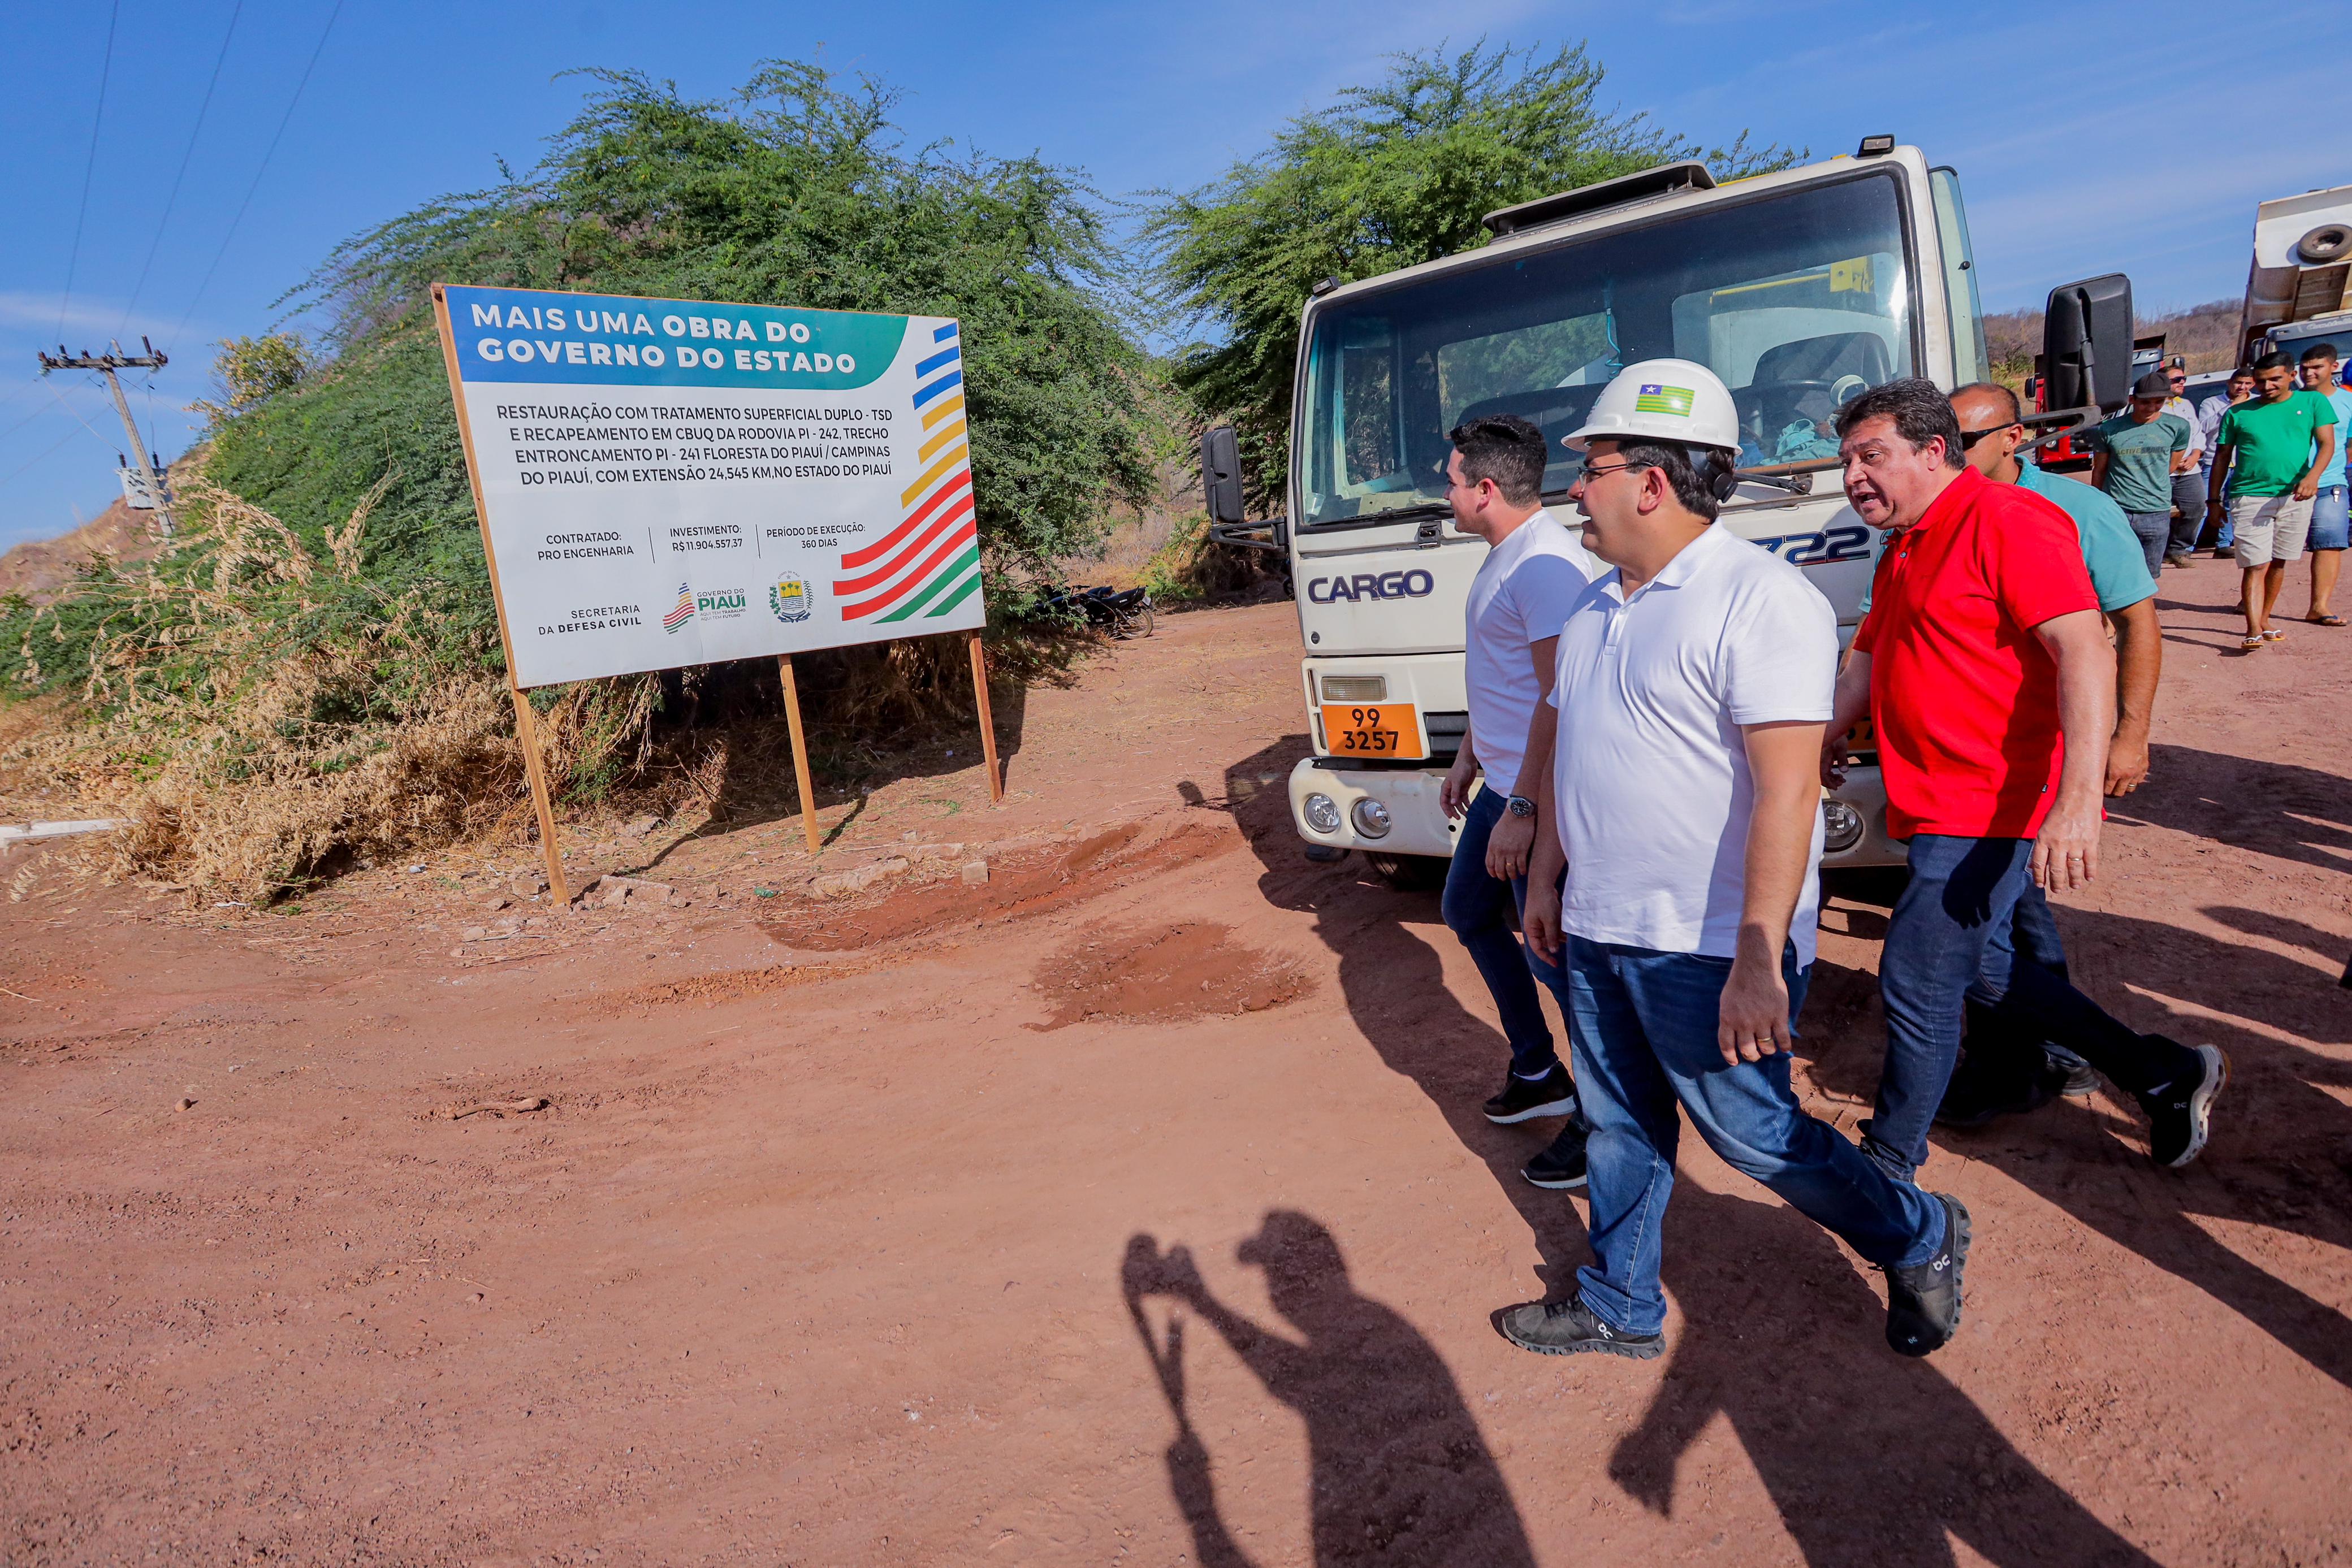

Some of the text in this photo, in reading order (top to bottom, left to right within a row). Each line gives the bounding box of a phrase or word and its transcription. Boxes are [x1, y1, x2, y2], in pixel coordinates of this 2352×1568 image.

[471, 304, 810, 343] MAIS UMA OBRA DO
[477, 337, 855, 373] GOVERNO DO ESTADO
[496, 402, 612, 423] RESTAURAÇÃO
[615, 406, 648, 419] COM
[650, 406, 741, 420] TRATAMENTO
[744, 408, 822, 421] SUPERFICIAL
[824, 409, 863, 421] DUPLO
[871, 409, 892, 421] TSD
[509, 427, 521, 441] E
[524, 427, 648, 441] RECAPEAMENTO
[651, 427, 672, 440] EM
[675, 427, 715, 443] CBUQ
[716, 427, 736, 440] DA
[738, 427, 796, 440] RODOVIA
[798, 427, 810, 439] PI
[819, 427, 842, 440] 242,
[843, 427, 889, 439] TRECHO
[515, 448, 652, 463] ENTRONCAMENTO
[655, 448, 668, 461] PI
[679, 448, 701, 460] 241
[703, 447, 769, 460] FLORESTA
[771, 447, 789, 459] DO
[791, 443, 823, 458] PIAUÍ
[831, 445, 890, 458] CAMPINAS
[521, 471, 544, 485] DO
[548, 466, 593, 484] PIAUÍ,
[595, 469, 629, 483] COM
[632, 464, 706, 481] EXTENSÃO
[708, 467, 749, 481] 24,545
[795, 465, 840, 478] ESTADO
[842, 465, 860, 476] DO
[862, 461, 892, 475] PIAUÍ
[546, 531, 622, 545] CONTRATADO:
[669, 525, 742, 538] INVESTIMENTO:
[766, 521, 866, 538] PERÍODO DE EXECUÇÃO:
[672, 538, 742, 553] R$ 11.904.557,37
[801, 538, 838, 549] 360 DIAS
[538, 545, 634, 561] PRO ENGENHARIA
[697, 589, 732, 597] GOVERNO
[1308, 569, 1434, 604] CARGO
[571, 604, 641, 620] SECRETARIA
[697, 594, 746, 612] PIAUÍ
[538, 617, 642, 635] DA DEFESA CIVIL
[1351, 708, 1381, 728] 99
[1342, 731, 1399, 751] 3257
